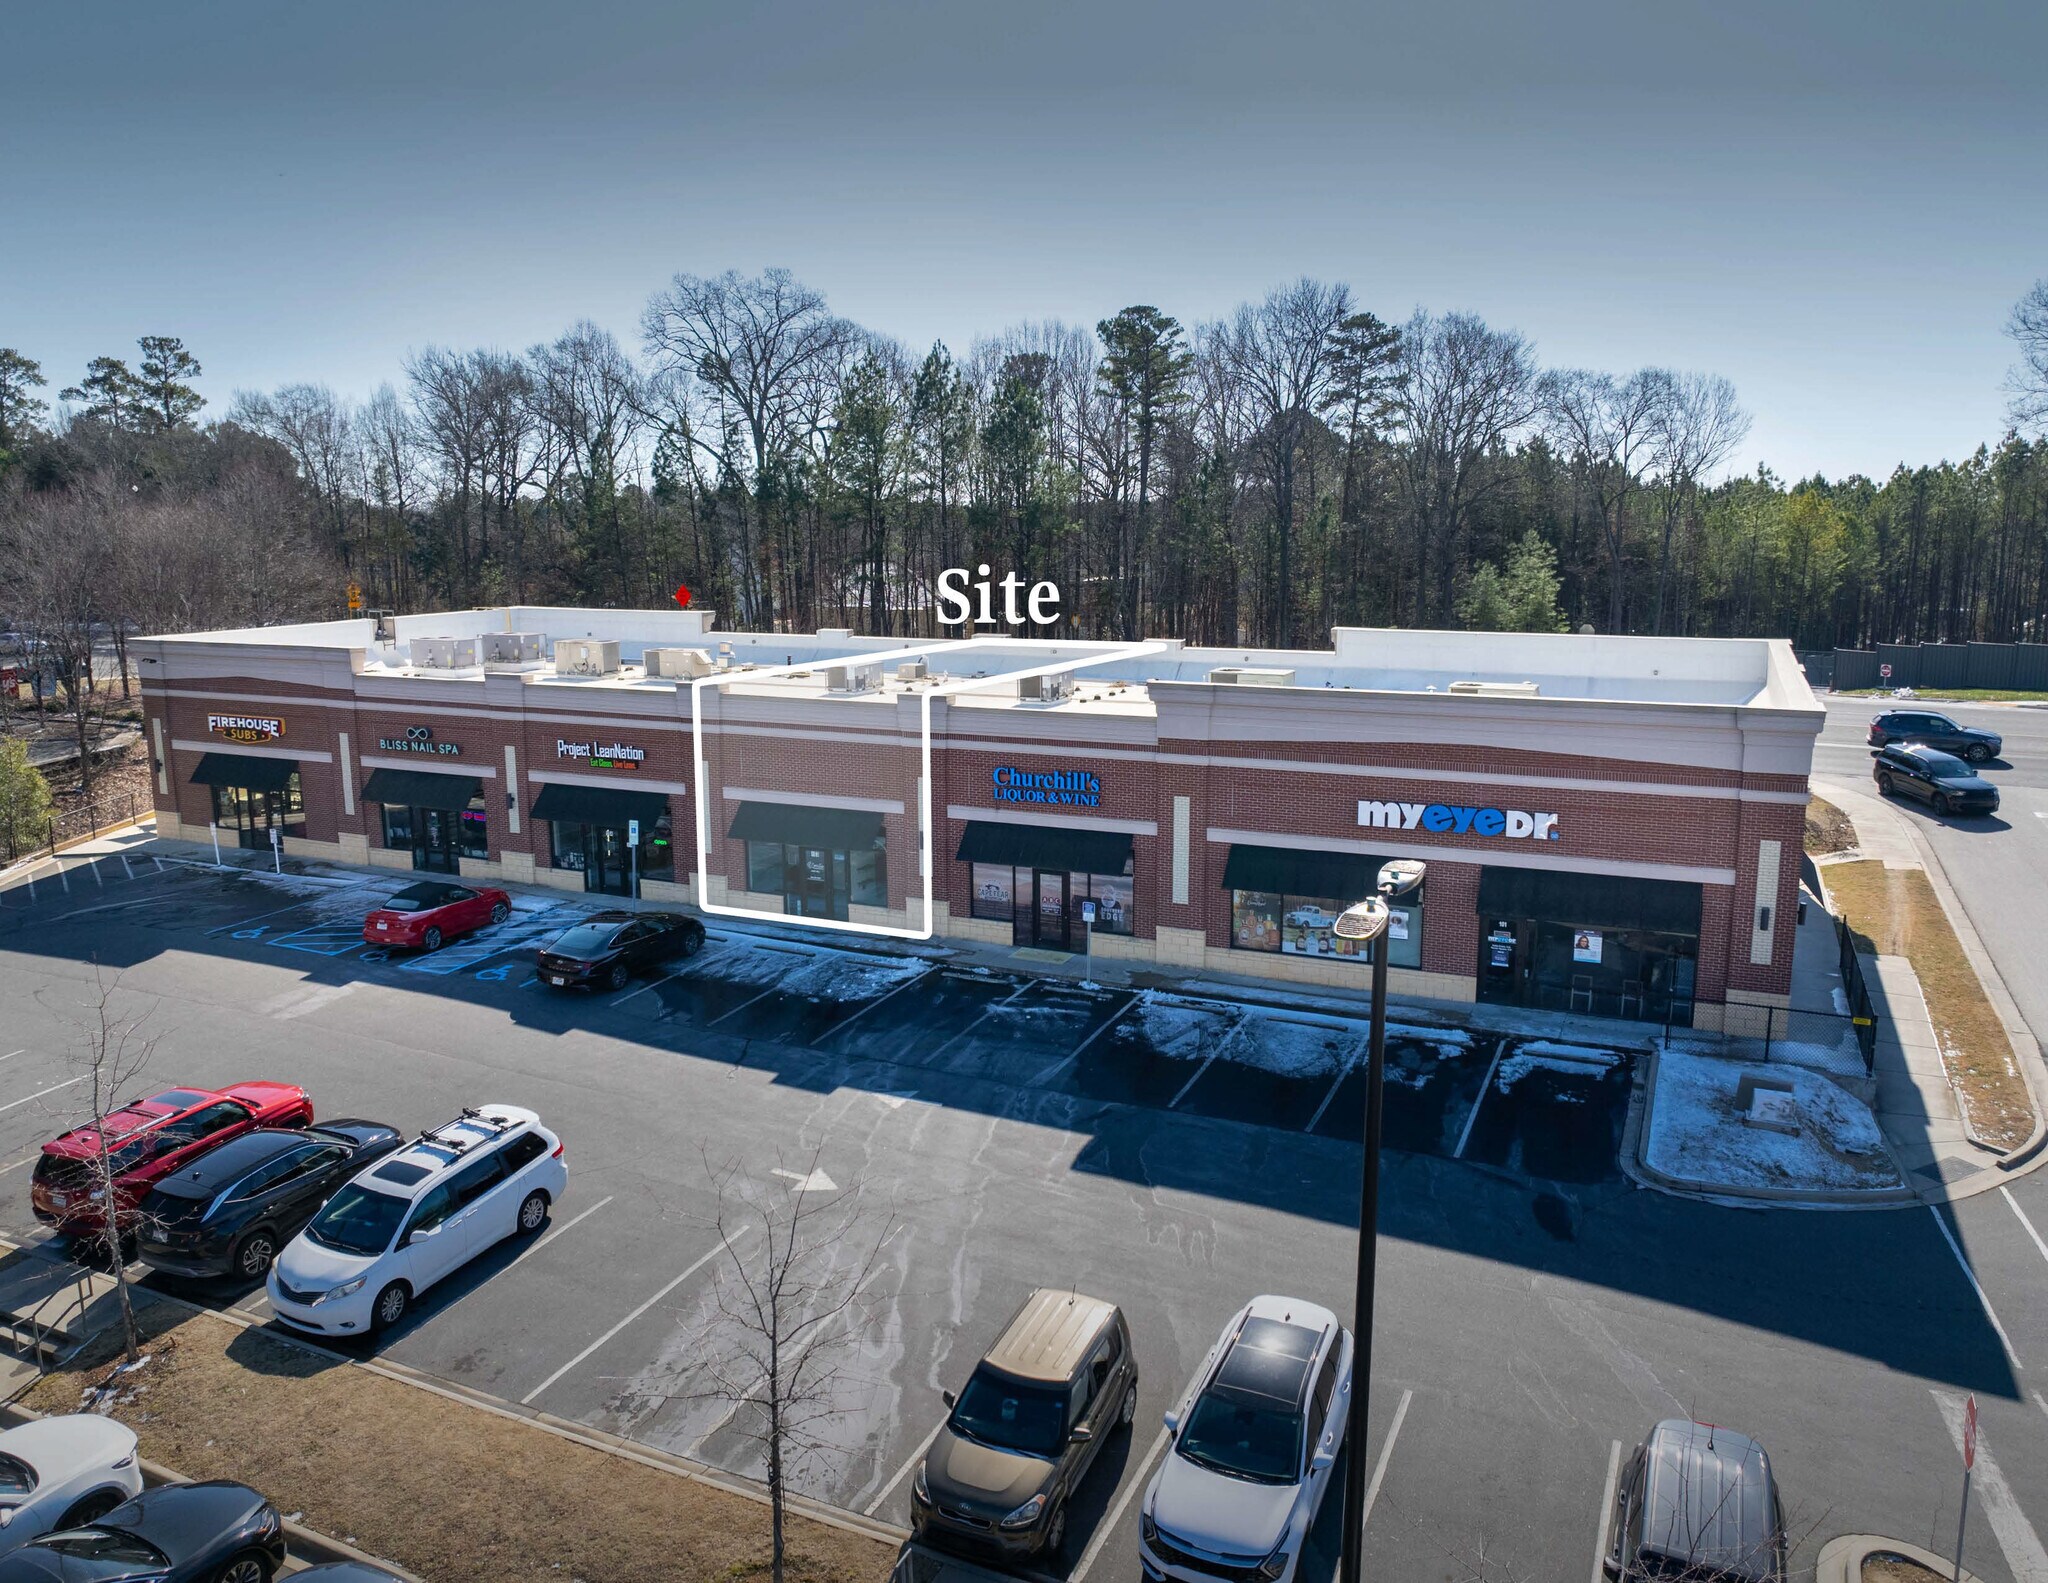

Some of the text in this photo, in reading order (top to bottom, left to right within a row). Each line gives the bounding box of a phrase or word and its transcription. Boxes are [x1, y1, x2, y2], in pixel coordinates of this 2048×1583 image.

[208, 716, 279, 737] FIREHOUSE
[231, 728, 257, 740] SUBS
[380, 739, 459, 755] BLISS NAIL SPA
[557, 740, 645, 761] Project LeanNation
[993, 767, 1100, 793] Churchill's
[993, 787, 1100, 807] LIQUOR & WINE
